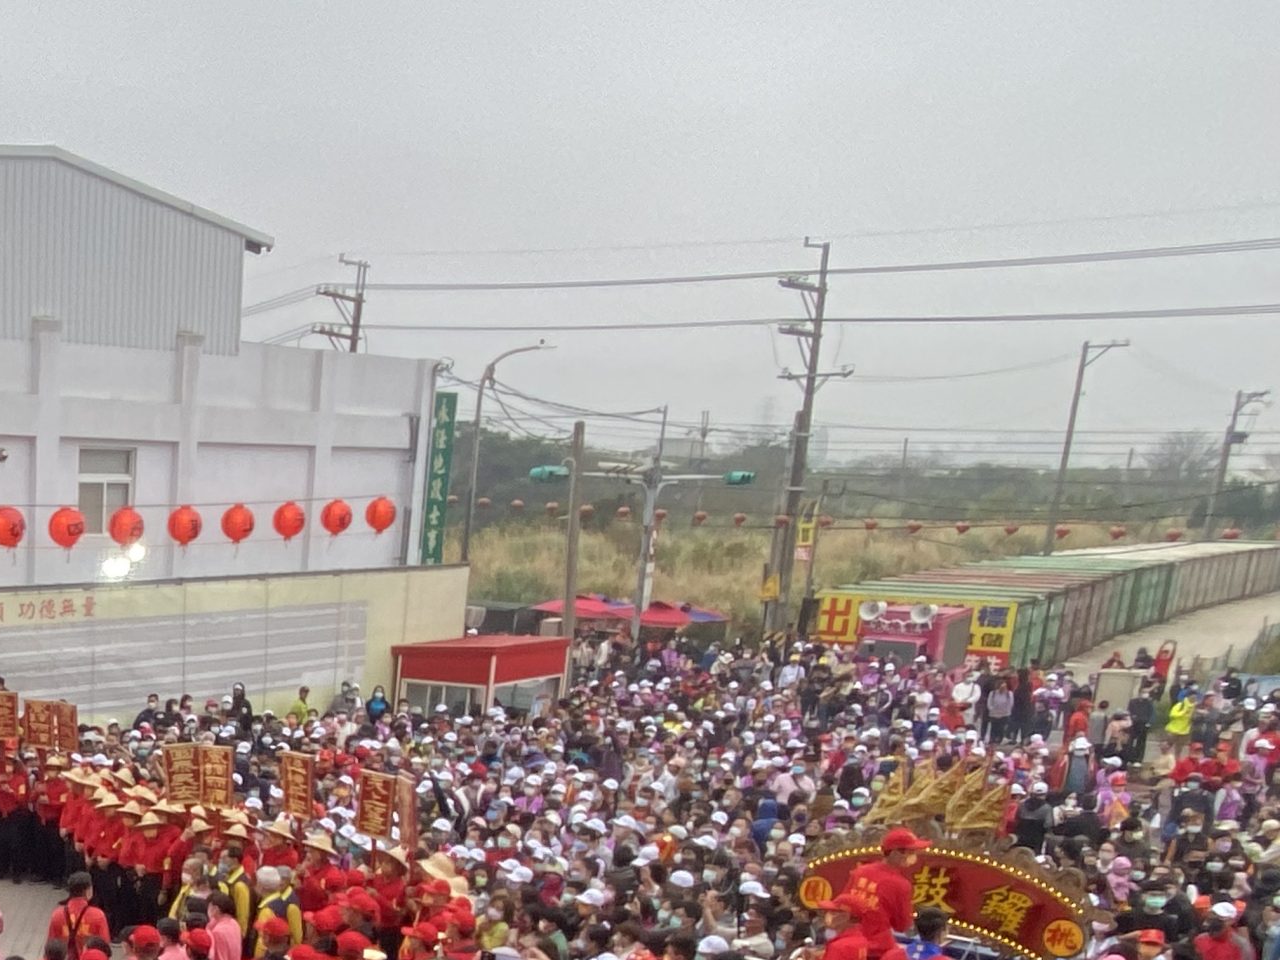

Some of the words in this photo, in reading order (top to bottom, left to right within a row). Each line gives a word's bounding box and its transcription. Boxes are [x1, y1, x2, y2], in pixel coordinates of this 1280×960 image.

[18, 596, 97, 621] 功德無量
[820, 597, 852, 637] 出
